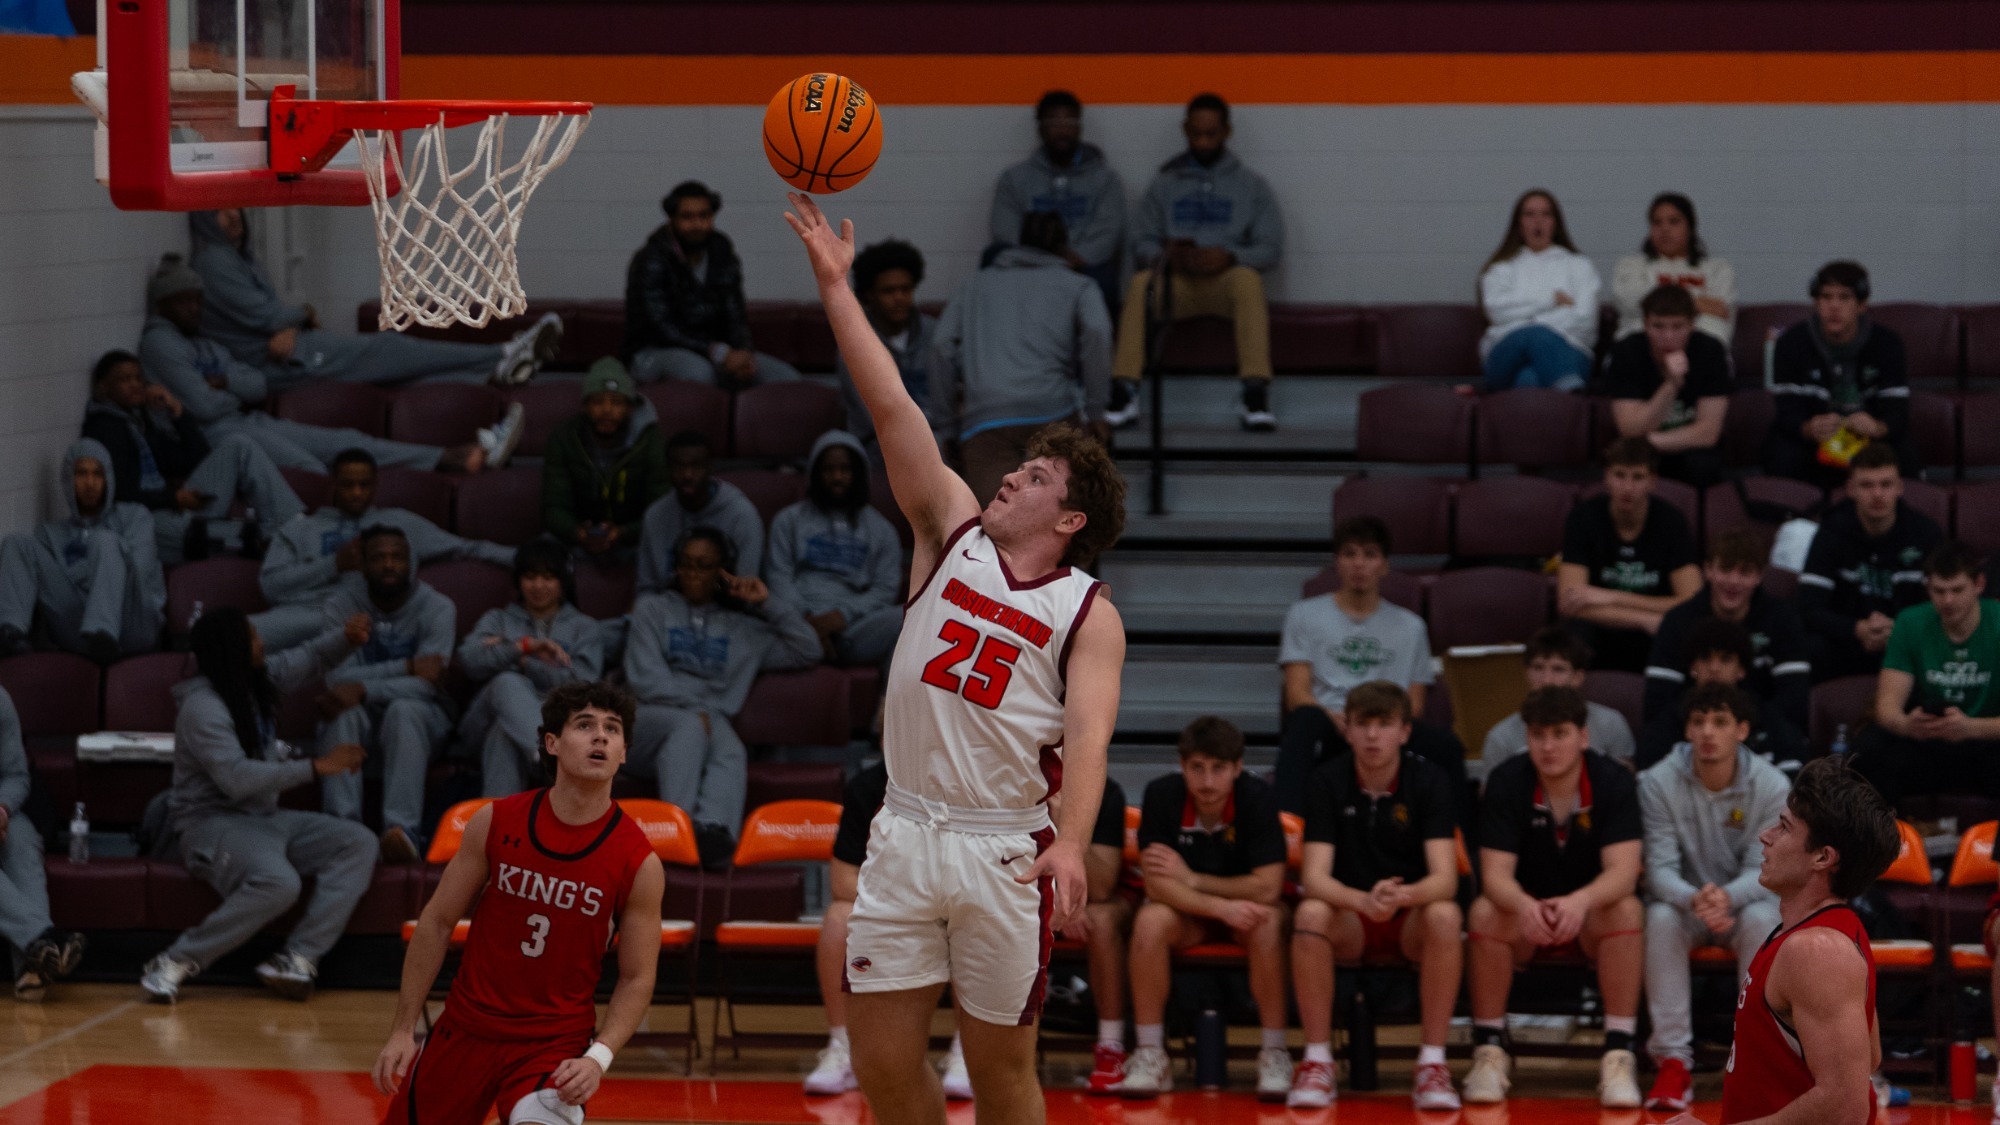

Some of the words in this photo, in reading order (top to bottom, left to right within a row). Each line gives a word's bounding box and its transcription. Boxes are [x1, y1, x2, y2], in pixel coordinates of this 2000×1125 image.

[804, 74, 827, 112] NCAA
[941, 577, 1053, 650] SUSQUEHANNA
[920, 618, 1022, 710] 25
[757, 818, 839, 840] Susquehann
[497, 862, 604, 917] KING'S
[520, 913, 551, 958] 3
